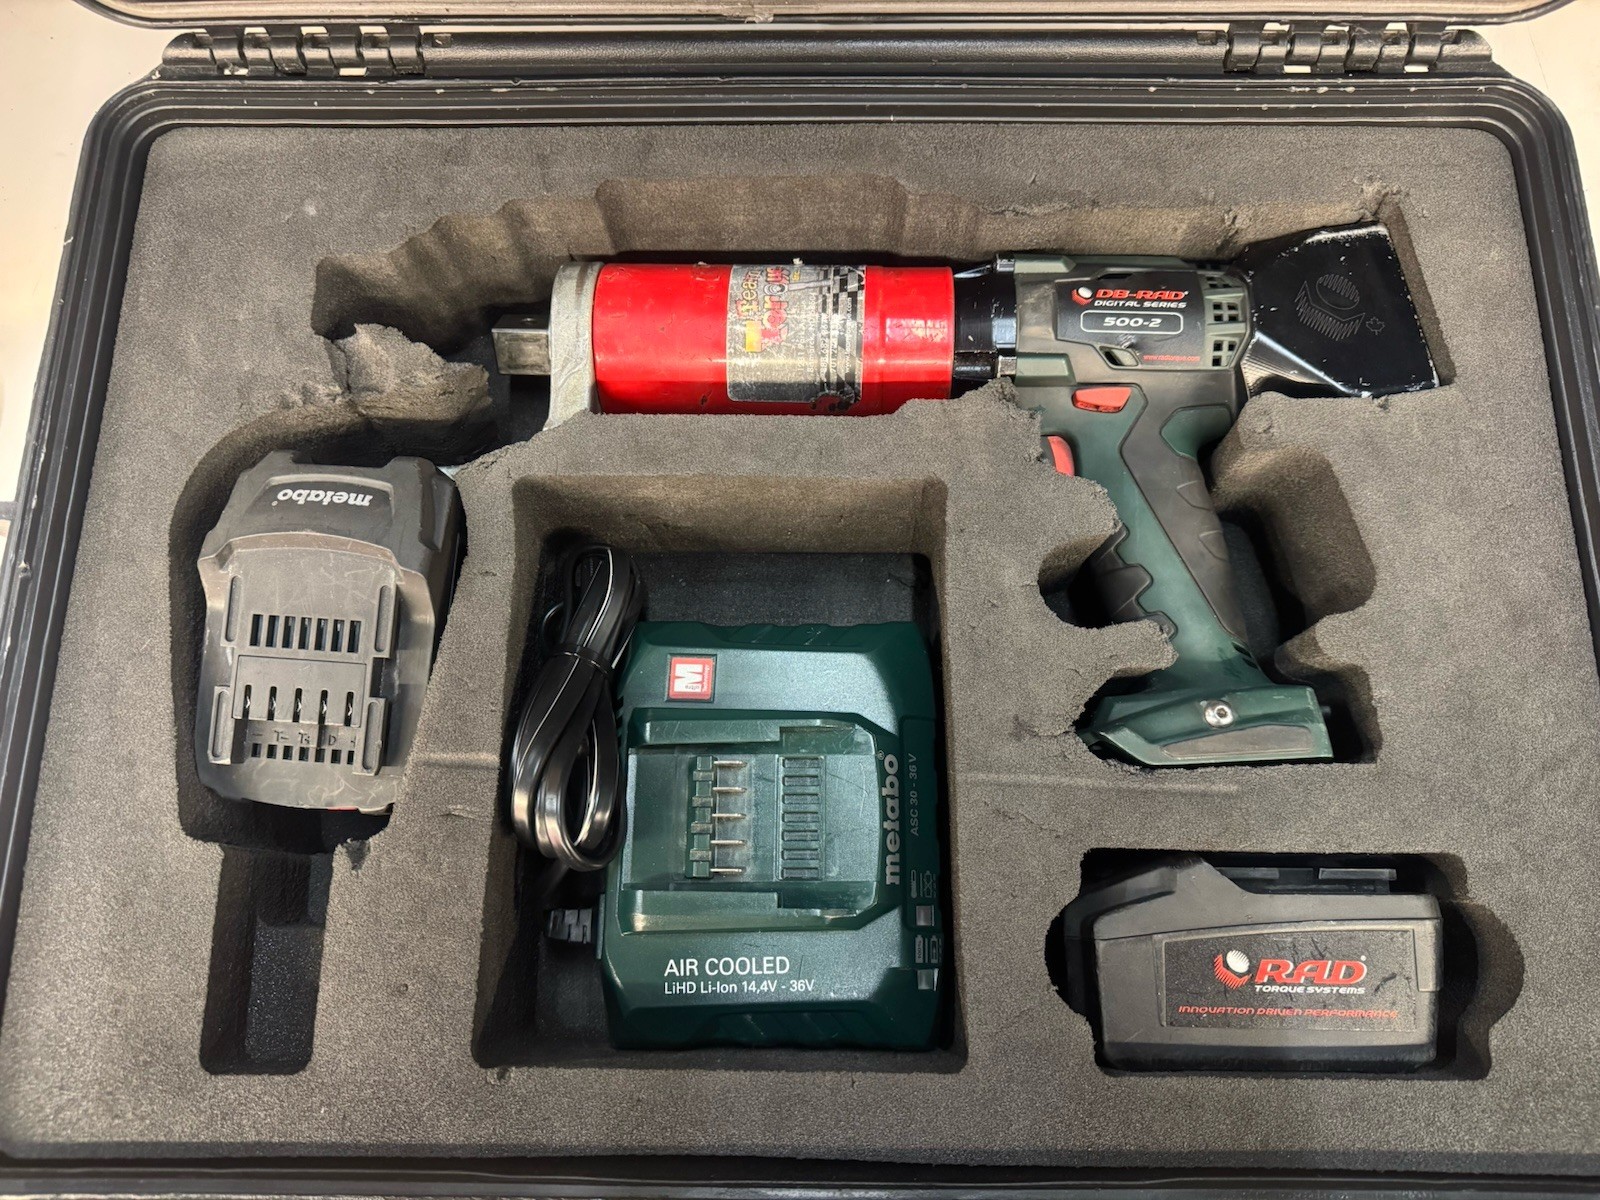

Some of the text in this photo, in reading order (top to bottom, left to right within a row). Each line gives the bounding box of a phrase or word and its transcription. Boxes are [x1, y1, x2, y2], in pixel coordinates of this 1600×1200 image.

[1095, 289, 1186, 300] DB-RAD
[1093, 299, 1187, 309] DIGITAL SERIES
[1103, 316, 1163, 328] 500-2
[276, 488, 374, 507] metabo
[909, 789, 918, 806] 30
[909, 806, 919, 836] ASC
[664, 956, 790, 977] AIR COOLED
[1255, 959, 1368, 985] RAD
[664, 981, 697, 995] LiHD
[700, 981, 738, 994] Li-Ion
[741, 979, 778, 994] 14,4V
[789, 978, 815, 992] 36V
[1254, 984, 1366, 995] TORQUE SYSTEMS
[1178, 1005, 1399, 1020] INNOVATION DRIVEN PERFORMANCE
